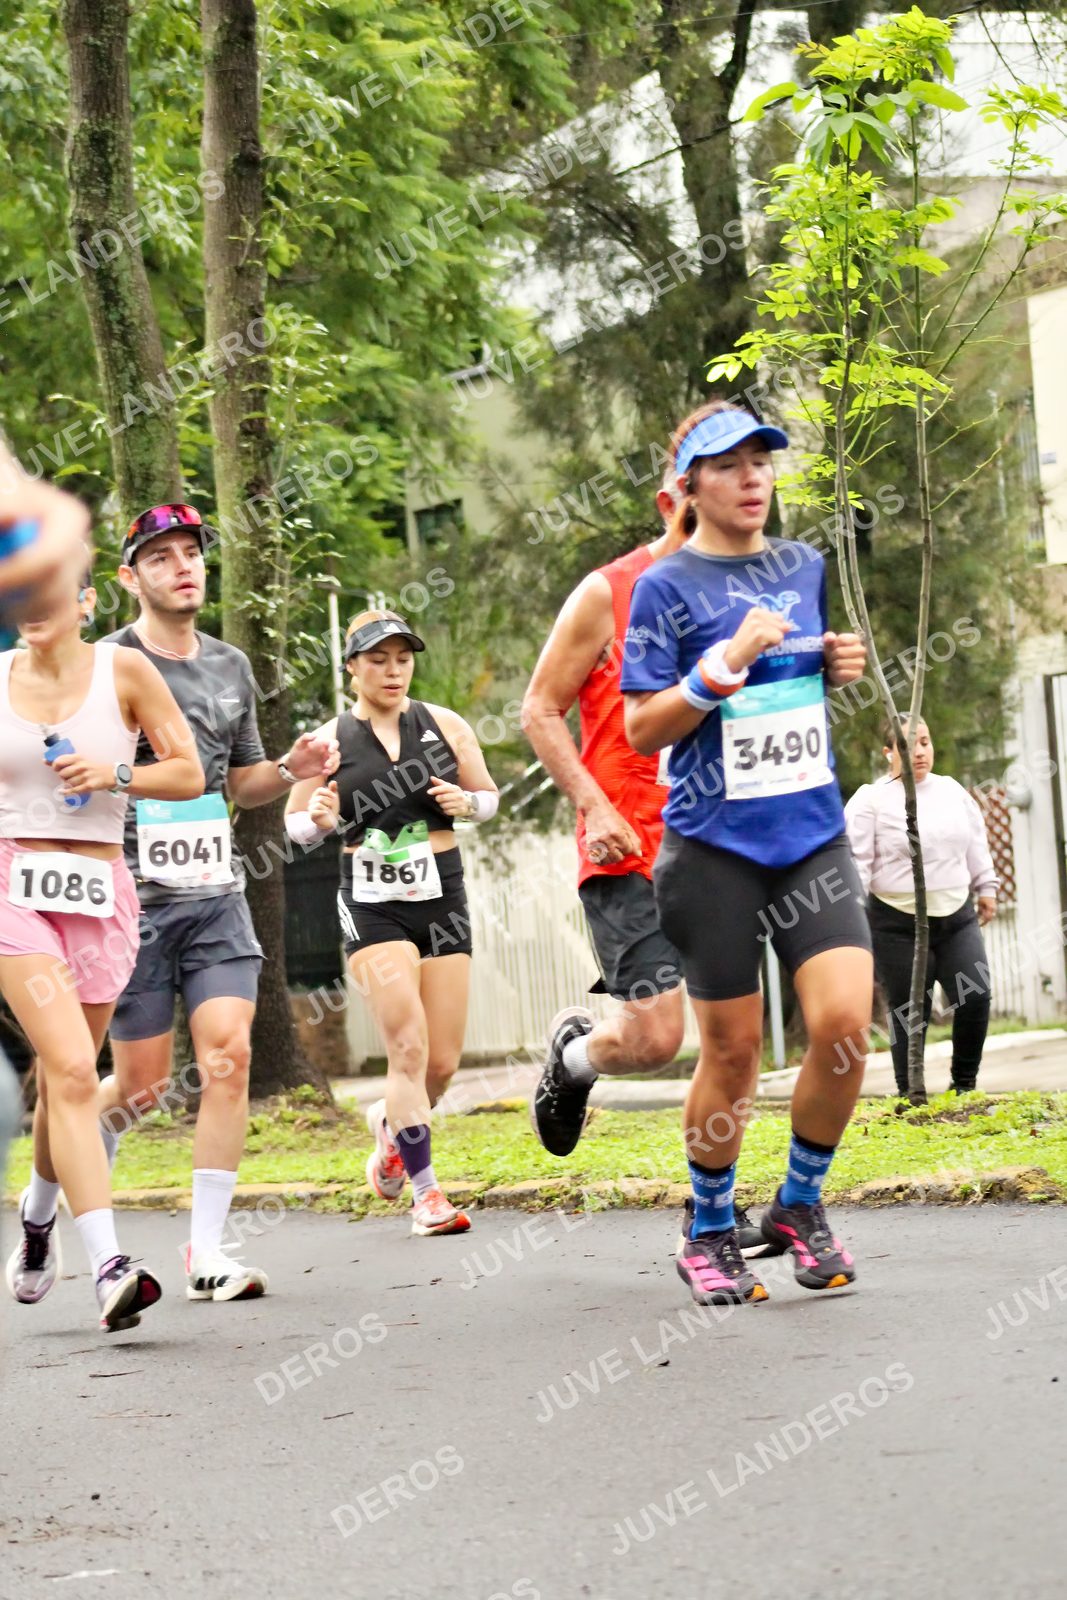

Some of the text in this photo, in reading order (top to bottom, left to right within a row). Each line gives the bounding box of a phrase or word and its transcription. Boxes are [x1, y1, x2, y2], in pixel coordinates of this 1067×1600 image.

[733, 726, 821, 771] 3490
[148, 836, 222, 867] 6041
[21, 868, 107, 905] 1086
[362, 857, 428, 885] 1867
